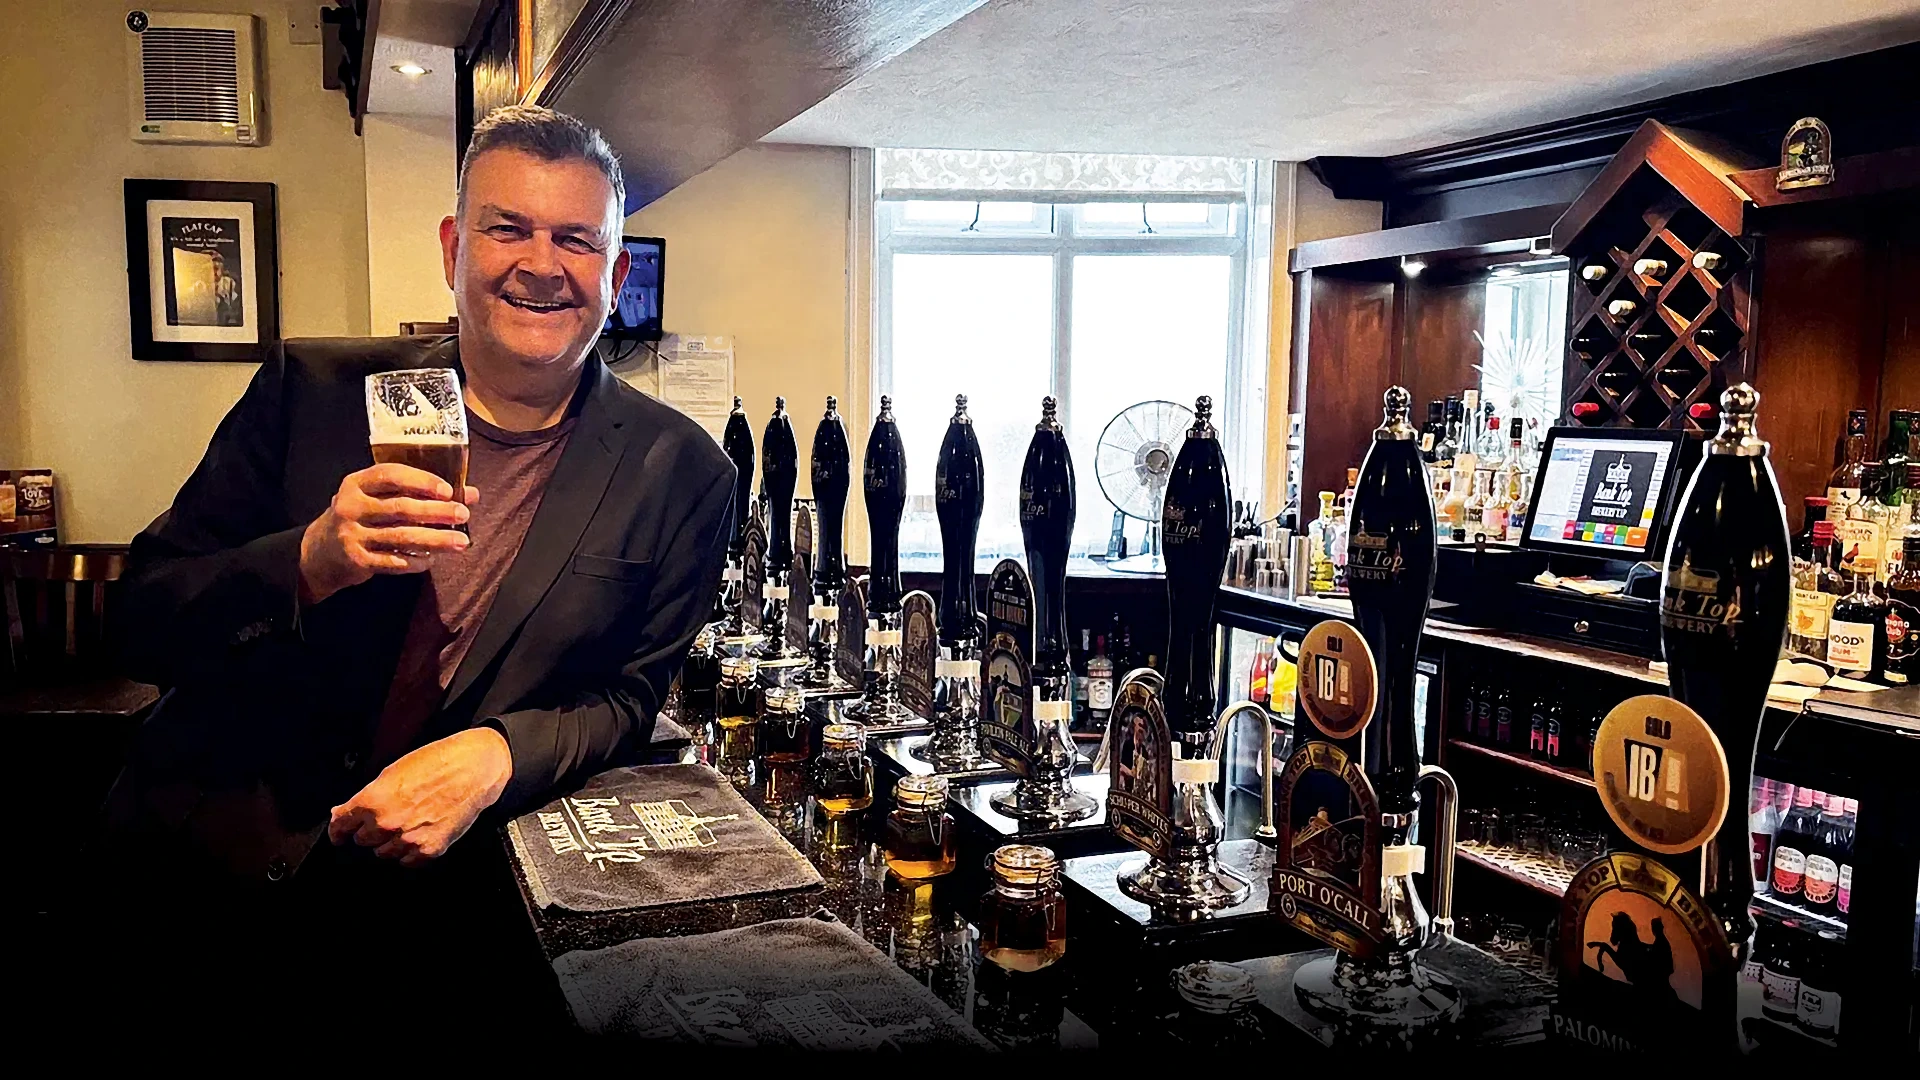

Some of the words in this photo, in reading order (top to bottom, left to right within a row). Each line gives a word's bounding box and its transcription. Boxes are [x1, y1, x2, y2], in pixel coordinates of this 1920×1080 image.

[181, 222, 202, 234] FLAT
[1373, 550, 1404, 573] Top
[1697, 595, 1741, 625] Top
[1580, 865, 1611, 894] TOP
[1279, 873, 1316, 899] PORT
[1320, 886, 1370, 930] O'CALL
[1554, 1014, 1645, 1053] PALOMIN
